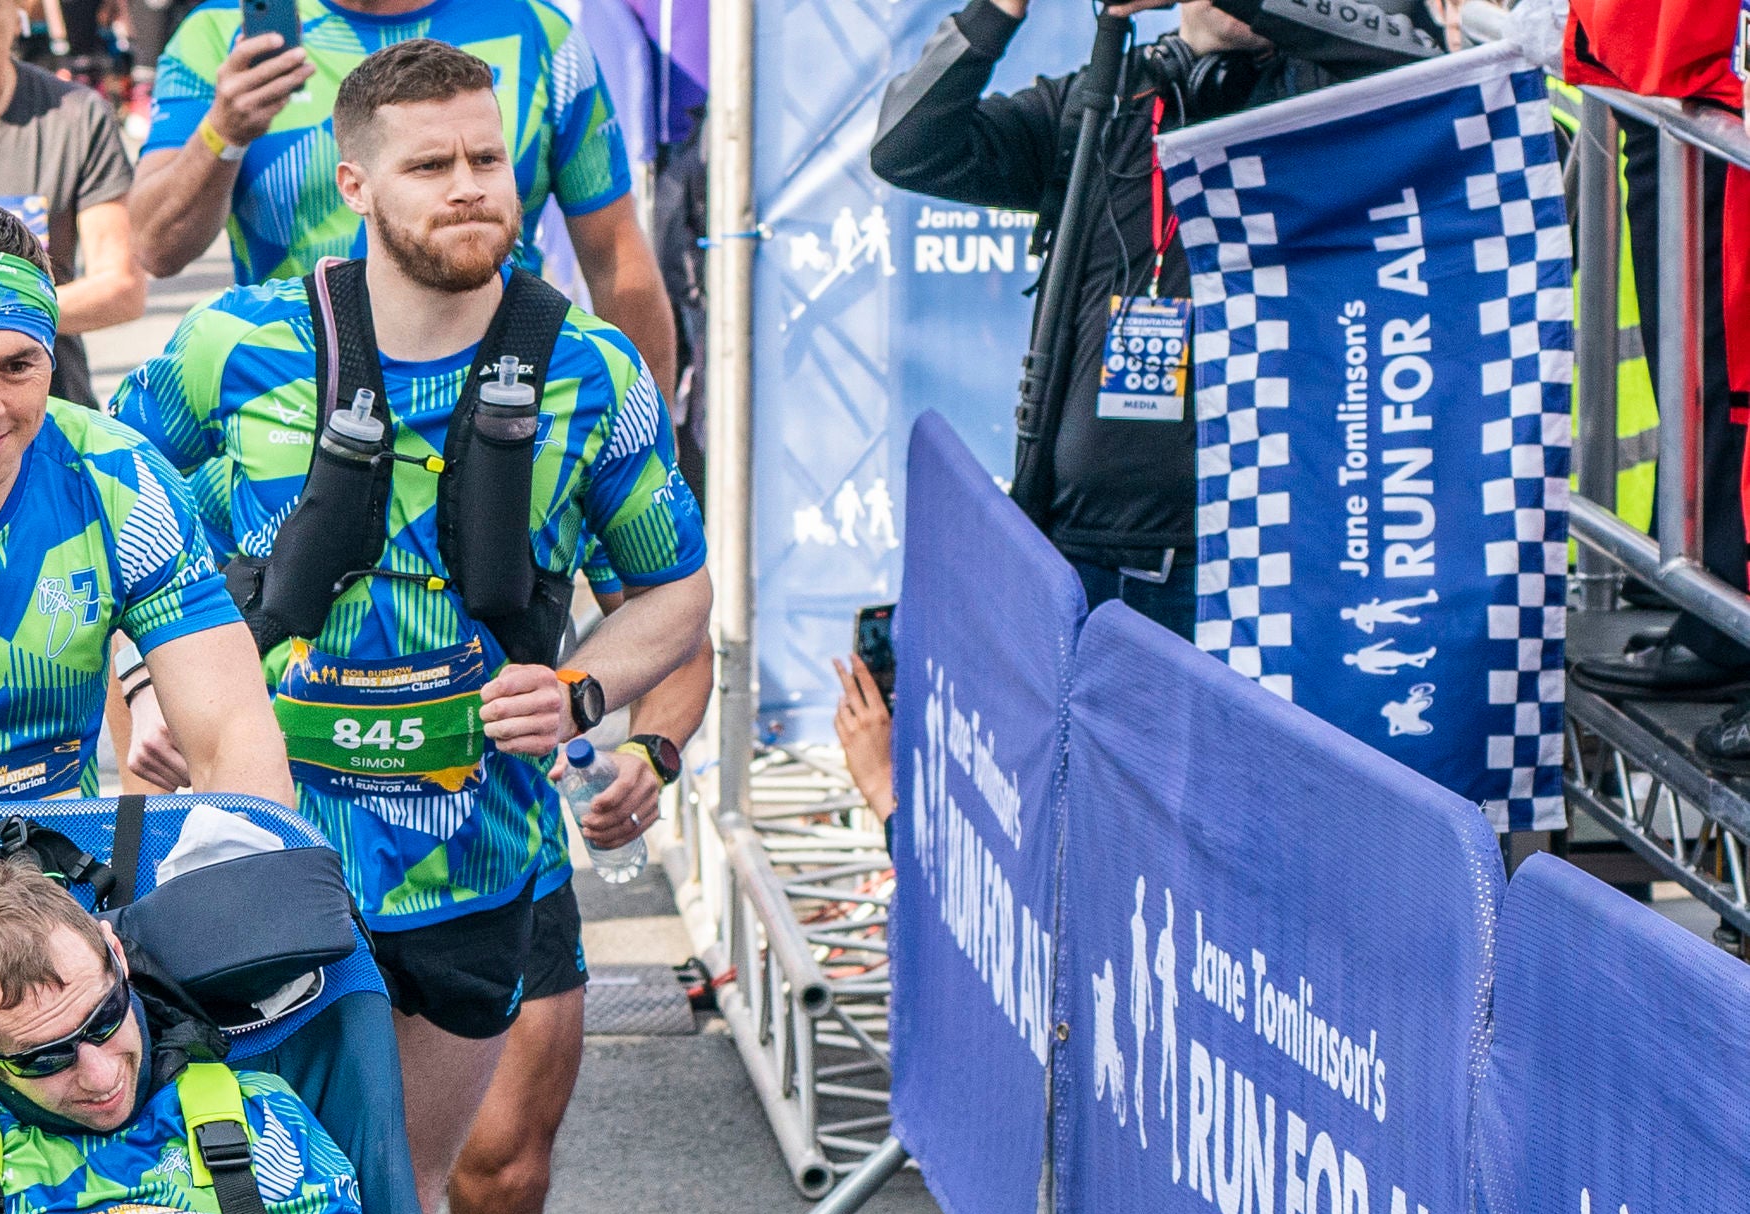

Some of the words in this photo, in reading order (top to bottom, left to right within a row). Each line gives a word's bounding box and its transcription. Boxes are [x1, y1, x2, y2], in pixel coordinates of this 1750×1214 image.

[917, 206, 980, 229] Jane
[986, 208, 1039, 228] Tom
[915, 235, 1015, 273] RUN
[1368, 187, 1429, 297] ALL
[492, 363, 534, 374] TEX
[1381, 313, 1434, 433] FOR
[1123, 400, 1158, 410] MEDIA
[1336, 300, 1368, 487] Tomlinson's
[268, 430, 311, 445] OXEN
[1381, 448, 1436, 579] RUN
[1339, 495, 1369, 578] Jane
[341, 675, 378, 687] LEEDS
[379, 664, 451, 687] MARATHON
[411, 678, 451, 693] Clarion
[332, 717, 426, 751] 845
[948, 680, 972, 776] Jane
[350, 756, 405, 769] SIMON
[9, 776, 47, 794] Clarion
[355, 782, 379, 792] RUN
[380, 783, 401, 793] FOR
[403, 783, 422, 792] ALL
[947, 795, 983, 972] RUN
[981, 847, 1017, 1027] FOR
[1192, 910, 1246, 1023] Jane
[1252, 948, 1387, 1123] Tomlinson's
